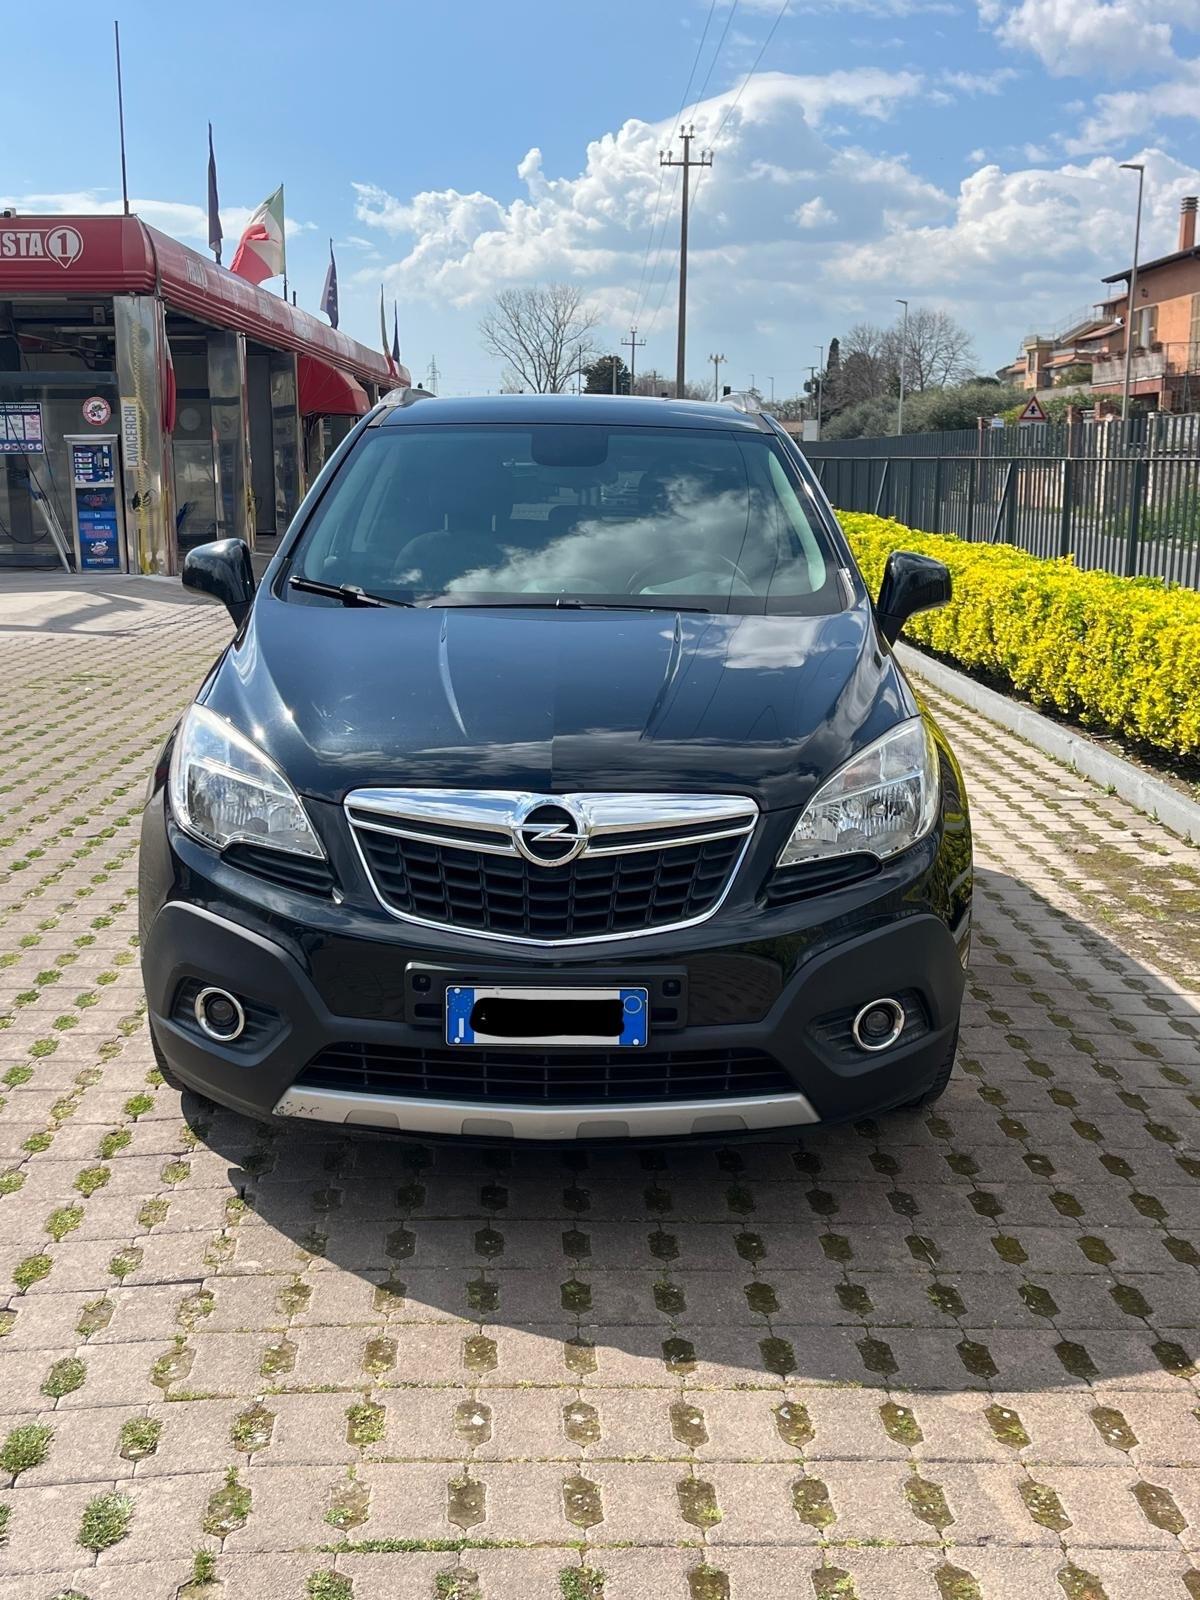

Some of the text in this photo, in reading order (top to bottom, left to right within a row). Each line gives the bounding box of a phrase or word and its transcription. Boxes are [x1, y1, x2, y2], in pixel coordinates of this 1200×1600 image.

[0, 232, 68, 257] STA 1
[124, 406, 139, 468] LAVACERCHI
[458, 1018, 465, 1038] I
